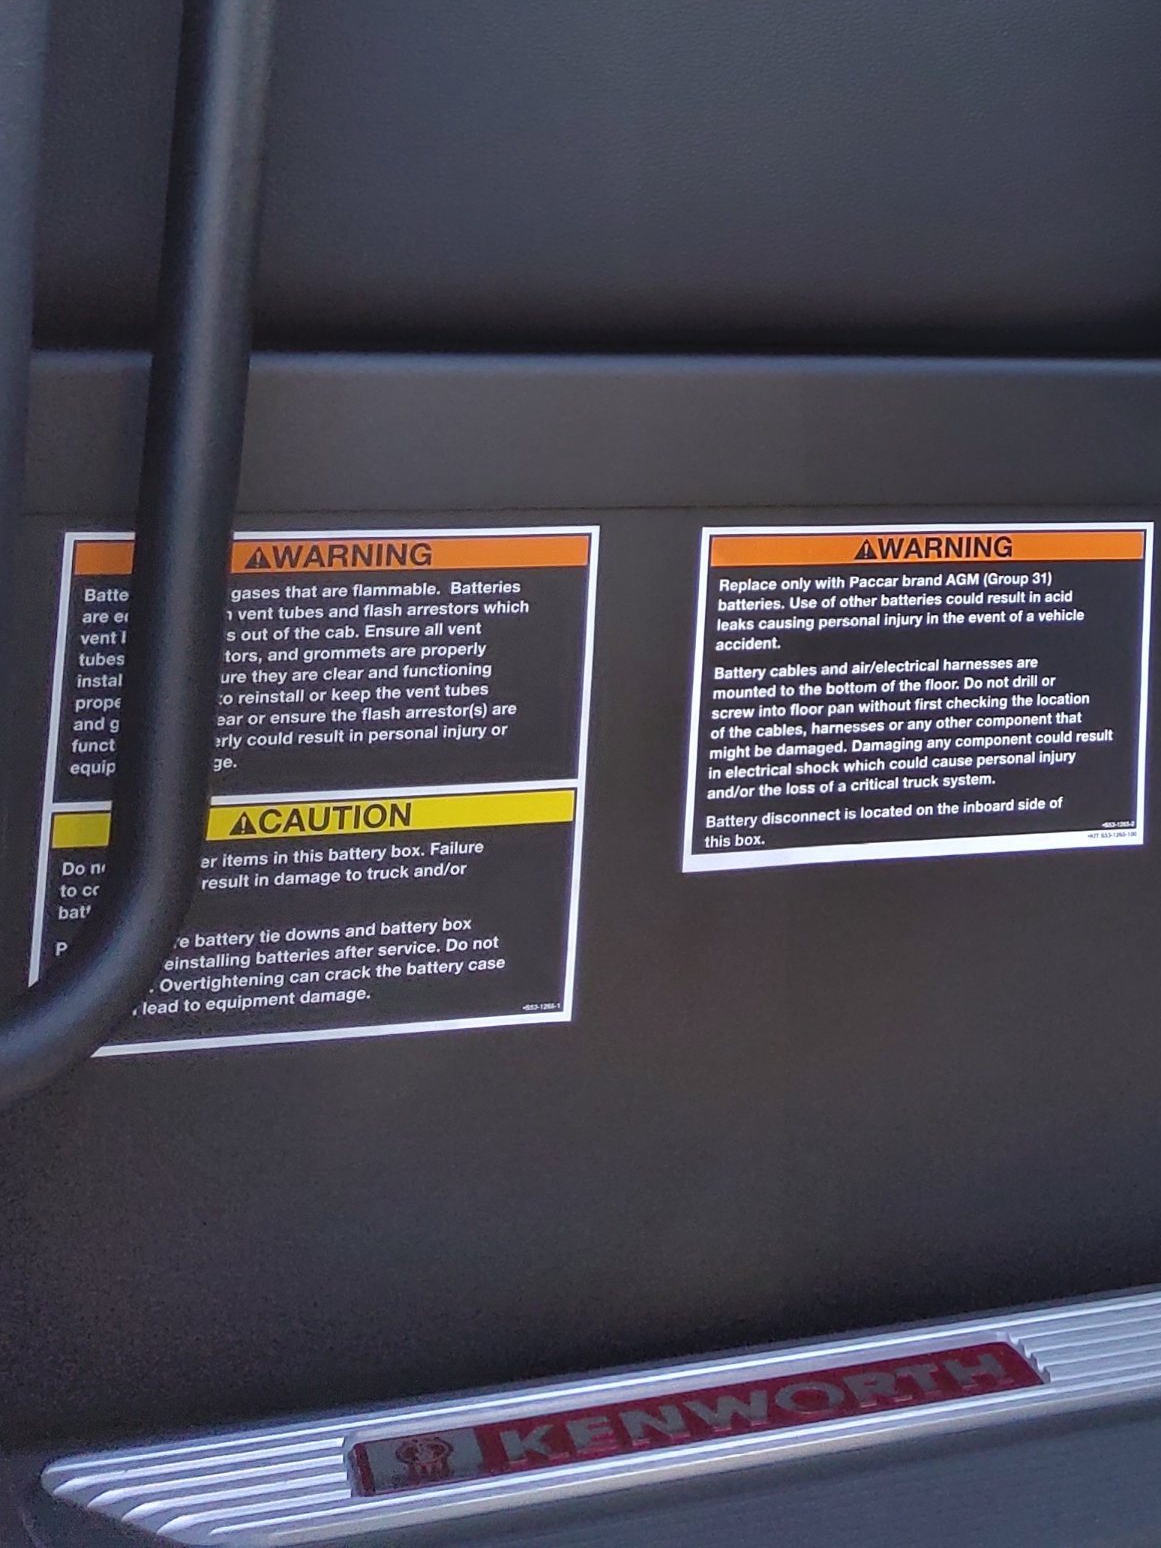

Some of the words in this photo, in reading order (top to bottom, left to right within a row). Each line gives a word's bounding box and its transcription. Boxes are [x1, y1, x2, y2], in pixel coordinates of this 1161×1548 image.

[272, 542, 433, 569] WARNING
[877, 535, 1013, 559] WARNING
[230, 588, 281, 603] gases
[284, 584, 318, 599] that
[321, 586, 348, 598] are
[351, 581, 441, 597] flammable.
[449, 579, 521, 595] Batteries
[718, 577, 778, 594] Replace
[780, 576, 812, 593] only
[814, 576, 845, 590] with
[848, 575, 899, 588] Paccar
[901, 573, 943, 587] brand
[944, 572, 980, 586] AGM
[982, 572, 1029, 588] (Group
[1031, 571, 1052, 587] 31)
[81, 612, 109, 623] are
[237, 606, 274, 620] vent
[277, 605, 324, 620] tubes
[327, 603, 359, 618] and
[362, 602, 402, 617] flash
[406, 602, 479, 616] arrestors
[482, 599, 530, 614] which
[717, 597, 785, 612] batteries.
[789, 595, 818, 610] Use
[820, 595, 837, 609] of
[838, 594, 878, 608] other
[880, 592, 943, 607] batteries
[945, 591, 984, 605] could
[986, 590, 1026, 604] result
[1028, 590, 1041, 603] in
[1044, 589, 1073, 603] acid
[716, 617, 755, 632] leaks
[757, 615, 815, 632] causing
[817, 613, 881, 631] personal
[883, 612, 923, 628] injury
[925, 611, 939, 625] in
[941, 611, 965, 624] the
[967, 610, 1006, 624] event
[1008, 609, 1024, 623] of
[1025, 611, 1035, 622] a
[1037, 608, 1085, 622] vehicle
[267, 646, 299, 662] and
[302, 645, 386, 663] grommets
[389, 646, 417, 658] are
[420, 641, 487, 660] properly
[714, 636, 781, 651] accident.
[250, 669, 288, 685] they
[291, 670, 318, 682] are
[322, 666, 365, 681] clear
[367, 664, 399, 679] and
[402, 661, 492, 678] functioning
[713, 666, 767, 681] Battery
[769, 663, 818, 678] cables
[820, 661, 848, 676] and
[850, 658, 940, 674] air/electrical
[942, 658, 1014, 671] harnesses
[1015, 658, 1039, 669] are
[712, 684, 777, 700] mounted
[779, 684, 795, 697] to
[798, 682, 822, 696] the
[825, 681, 877, 695] bottom
[880, 679, 896, 693] of
[898, 678, 922, 692] the
[924, 677, 960, 691] floor.
[963, 676, 983, 690] Do
[986, 675, 1010, 689] not
[1011, 674, 1038, 688] drill
[1040, 676, 1056, 687] or
[246, 730, 293, 746] could
[297, 729, 345, 744] result
[348, 728, 364, 742] in
[367, 724, 438, 744] personal
[442, 723, 487, 741] injury
[490, 724, 509, 736] or
[708, 744, 751, 762] might
[753, 744, 773, 758] be
[775, 739, 848, 757] damaged.
[850, 736, 923, 753] Damaging
[925, 737, 952, 751] any
[954, 732, 1033, 749] component
[1034, 730, 1073, 744] could
[1075, 728, 1114, 743] result
[258, 802, 412, 833] CAUTION
[705, 814, 758, 829] Battery
[760, 807, 841, 825] disconnect
[843, 807, 857, 820] is
[859, 803, 913, 819] located
[915, 805, 934, 816] on
[936, 801, 960, 815] the
[962, 798, 1015, 814] inboard
[1017, 797, 1046, 811] side
[1048, 795, 1064, 809] of
[704, 834, 731, 849] this
[734, 833, 765, 847] box.
[61, 861, 85, 876] Do
[222, 853, 268, 867] items
[273, 850, 288, 865] in
[292, 848, 324, 864] this
[327, 846, 387, 862] battery
[390, 844, 425, 858] box.
[429, 840, 484, 856] Failure
[60, 884, 77, 898] to
[201, 873, 249, 890] result
[253, 872, 269, 887] in
[273, 871, 341, 886] damage
[345, 868, 363, 882] to
[366, 864, 409, 881] truck
[413, 861, 468, 878] and/or
[159, 971, 285, 993] Overtightening
[289, 971, 320, 984] can
[324, 964, 371, 981] crack
[374, 963, 402, 978] the
[405, 960, 464, 976] battery
[467, 958, 506, 971] case
[142, 998, 179, 1015] lead
[183, 998, 201, 1012] to
[205, 991, 296, 1013] equipment
[299, 988, 371, 1004] damage.
[499, 1352, 1010, 1465] KENWORTH
